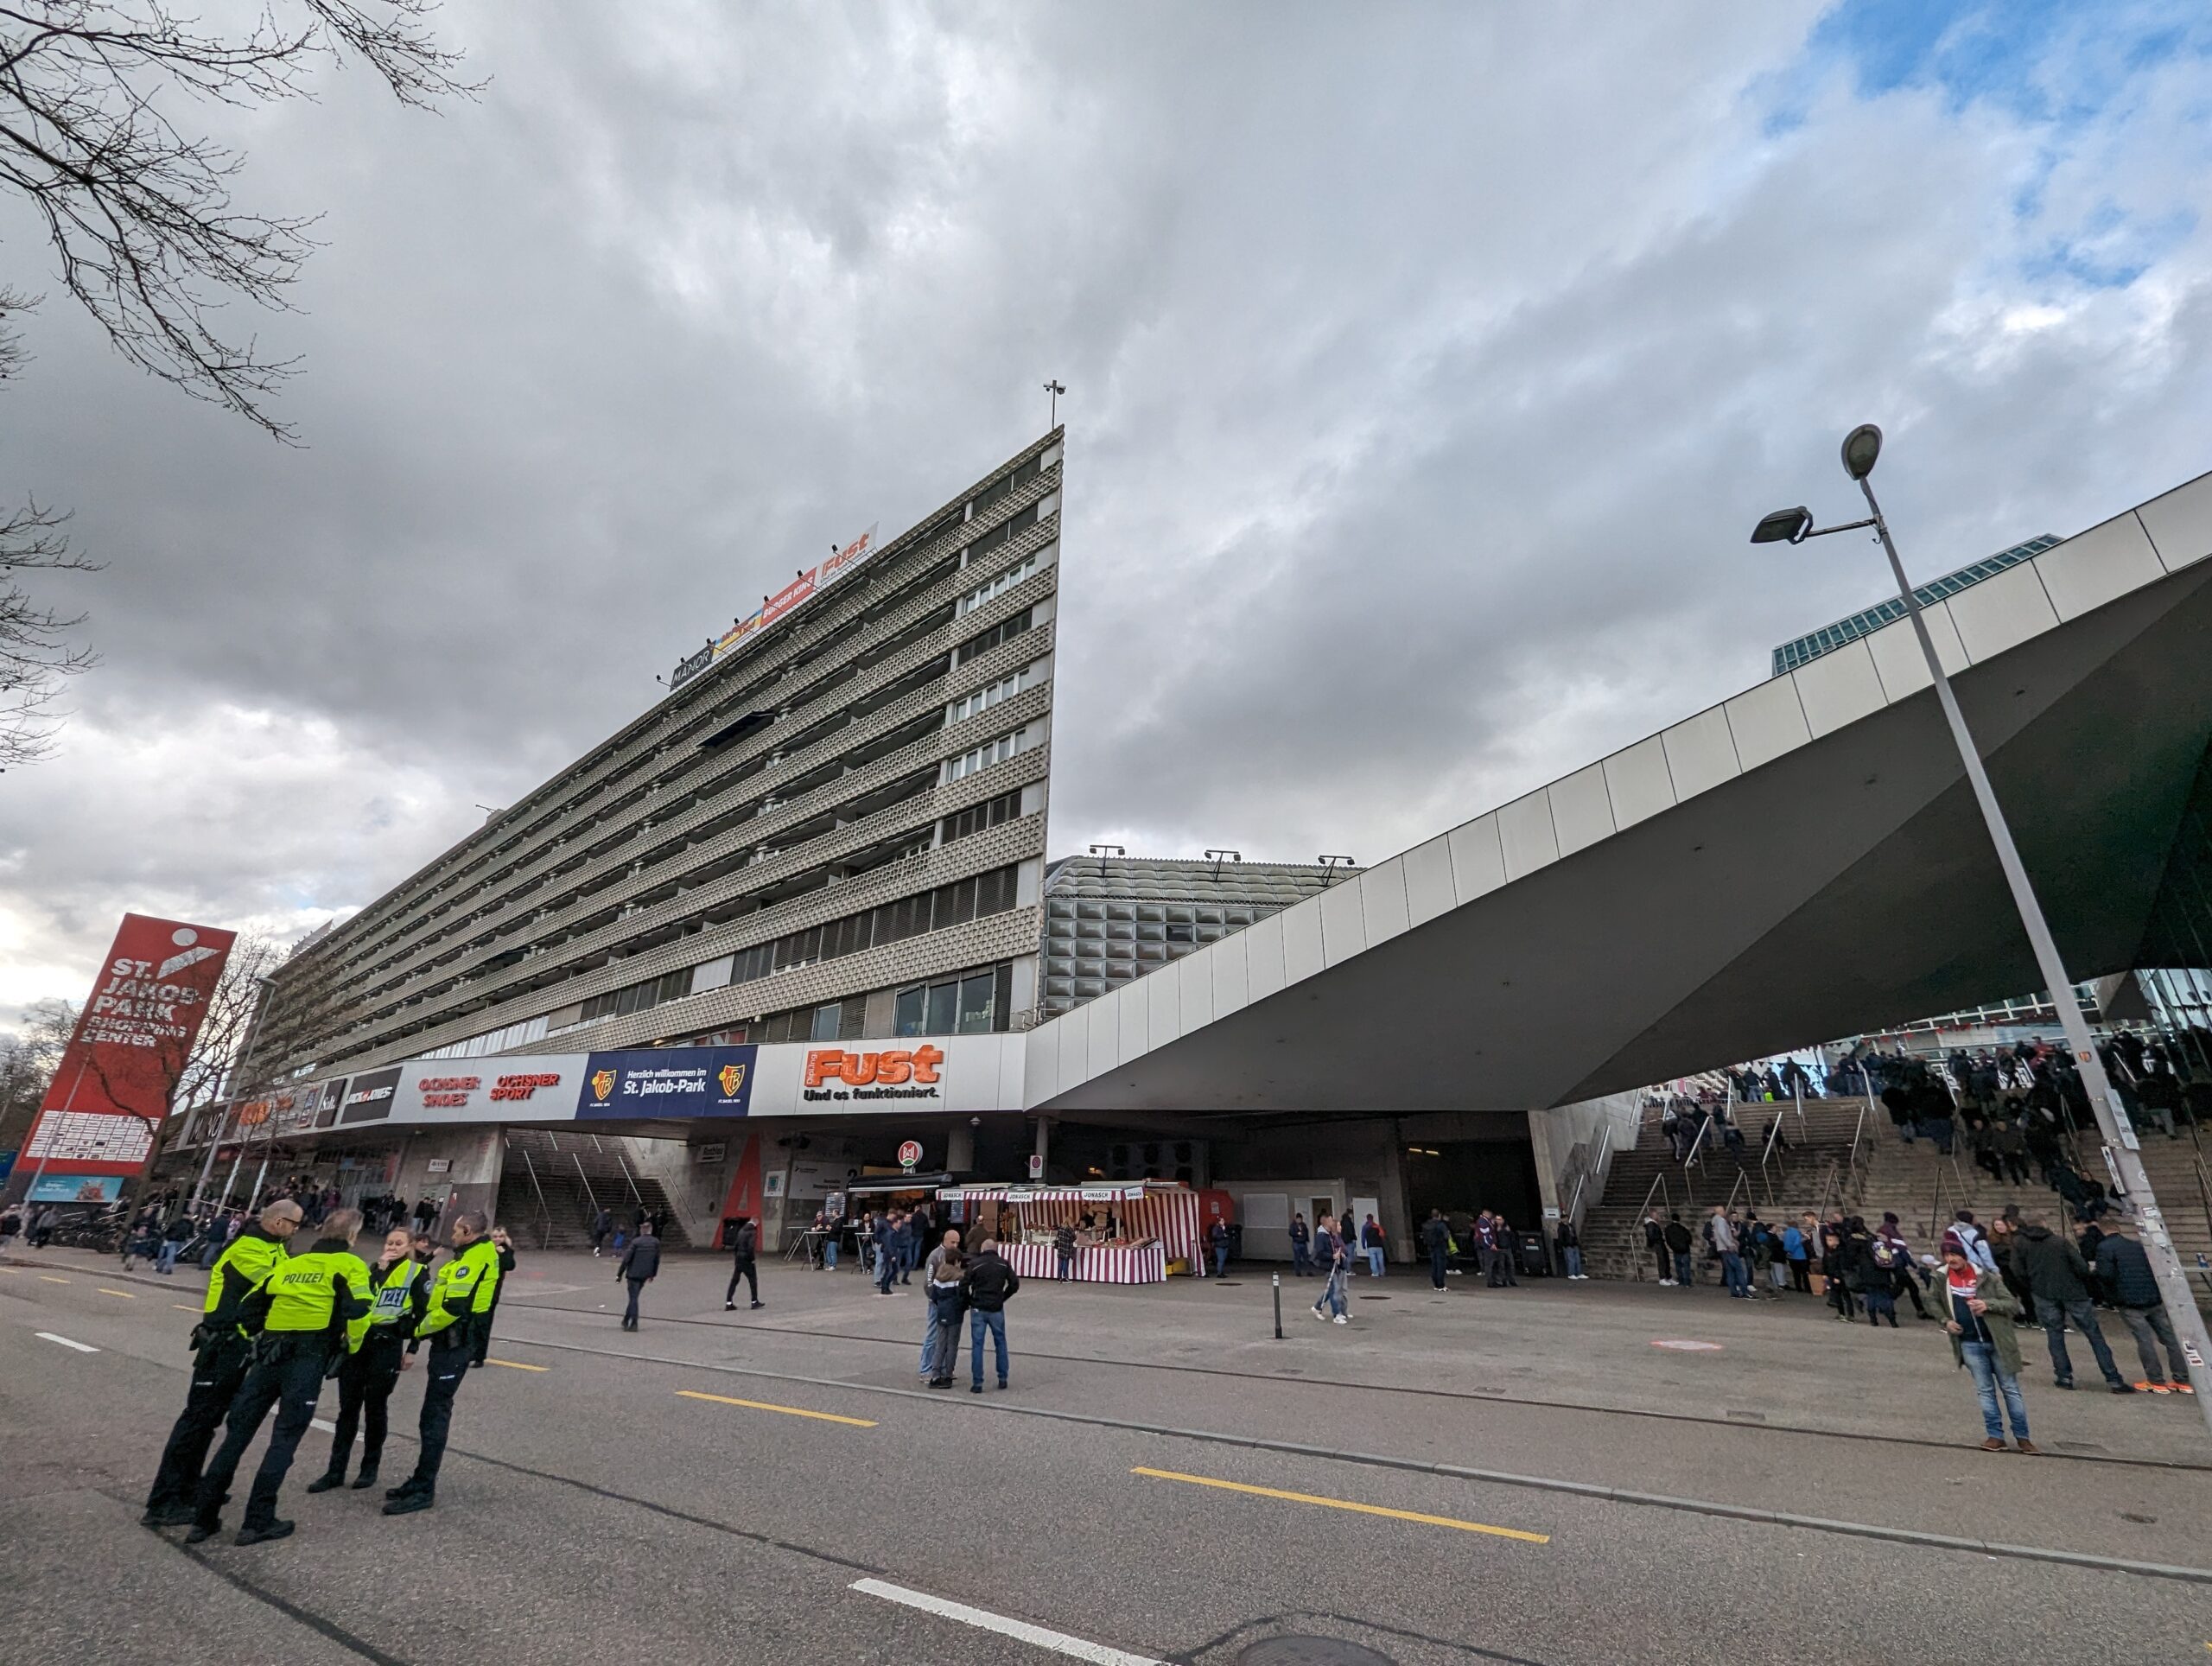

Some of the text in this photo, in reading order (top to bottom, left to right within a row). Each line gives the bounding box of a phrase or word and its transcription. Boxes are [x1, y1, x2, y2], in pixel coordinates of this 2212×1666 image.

[822, 533, 869, 580] Fust
[763, 592, 792, 619] BURGER
[793, 576, 813, 597] KING
[674, 650, 709, 682] MANOR
[111, 958, 152, 979] ST.
[92, 995, 177, 1021] PARK
[79, 1028, 156, 1047] CENTER
[627, 1068, 707, 1078] Herzlich willkommen im
[804, 1045, 944, 1087] Fust
[419, 1076, 481, 1091] OCHSNER
[498, 1073, 561, 1088] OCHSNER
[623, 1078, 706, 1097] St. Jakob-Park
[423, 1093, 468, 1107] SHOES
[490, 1087, 536, 1101] SPORT
[804, 1086, 939, 1102] Und es funktioniert.
[903, 1145, 915, 1159] Bell
[282, 1272, 324, 1285] POLIZEI
